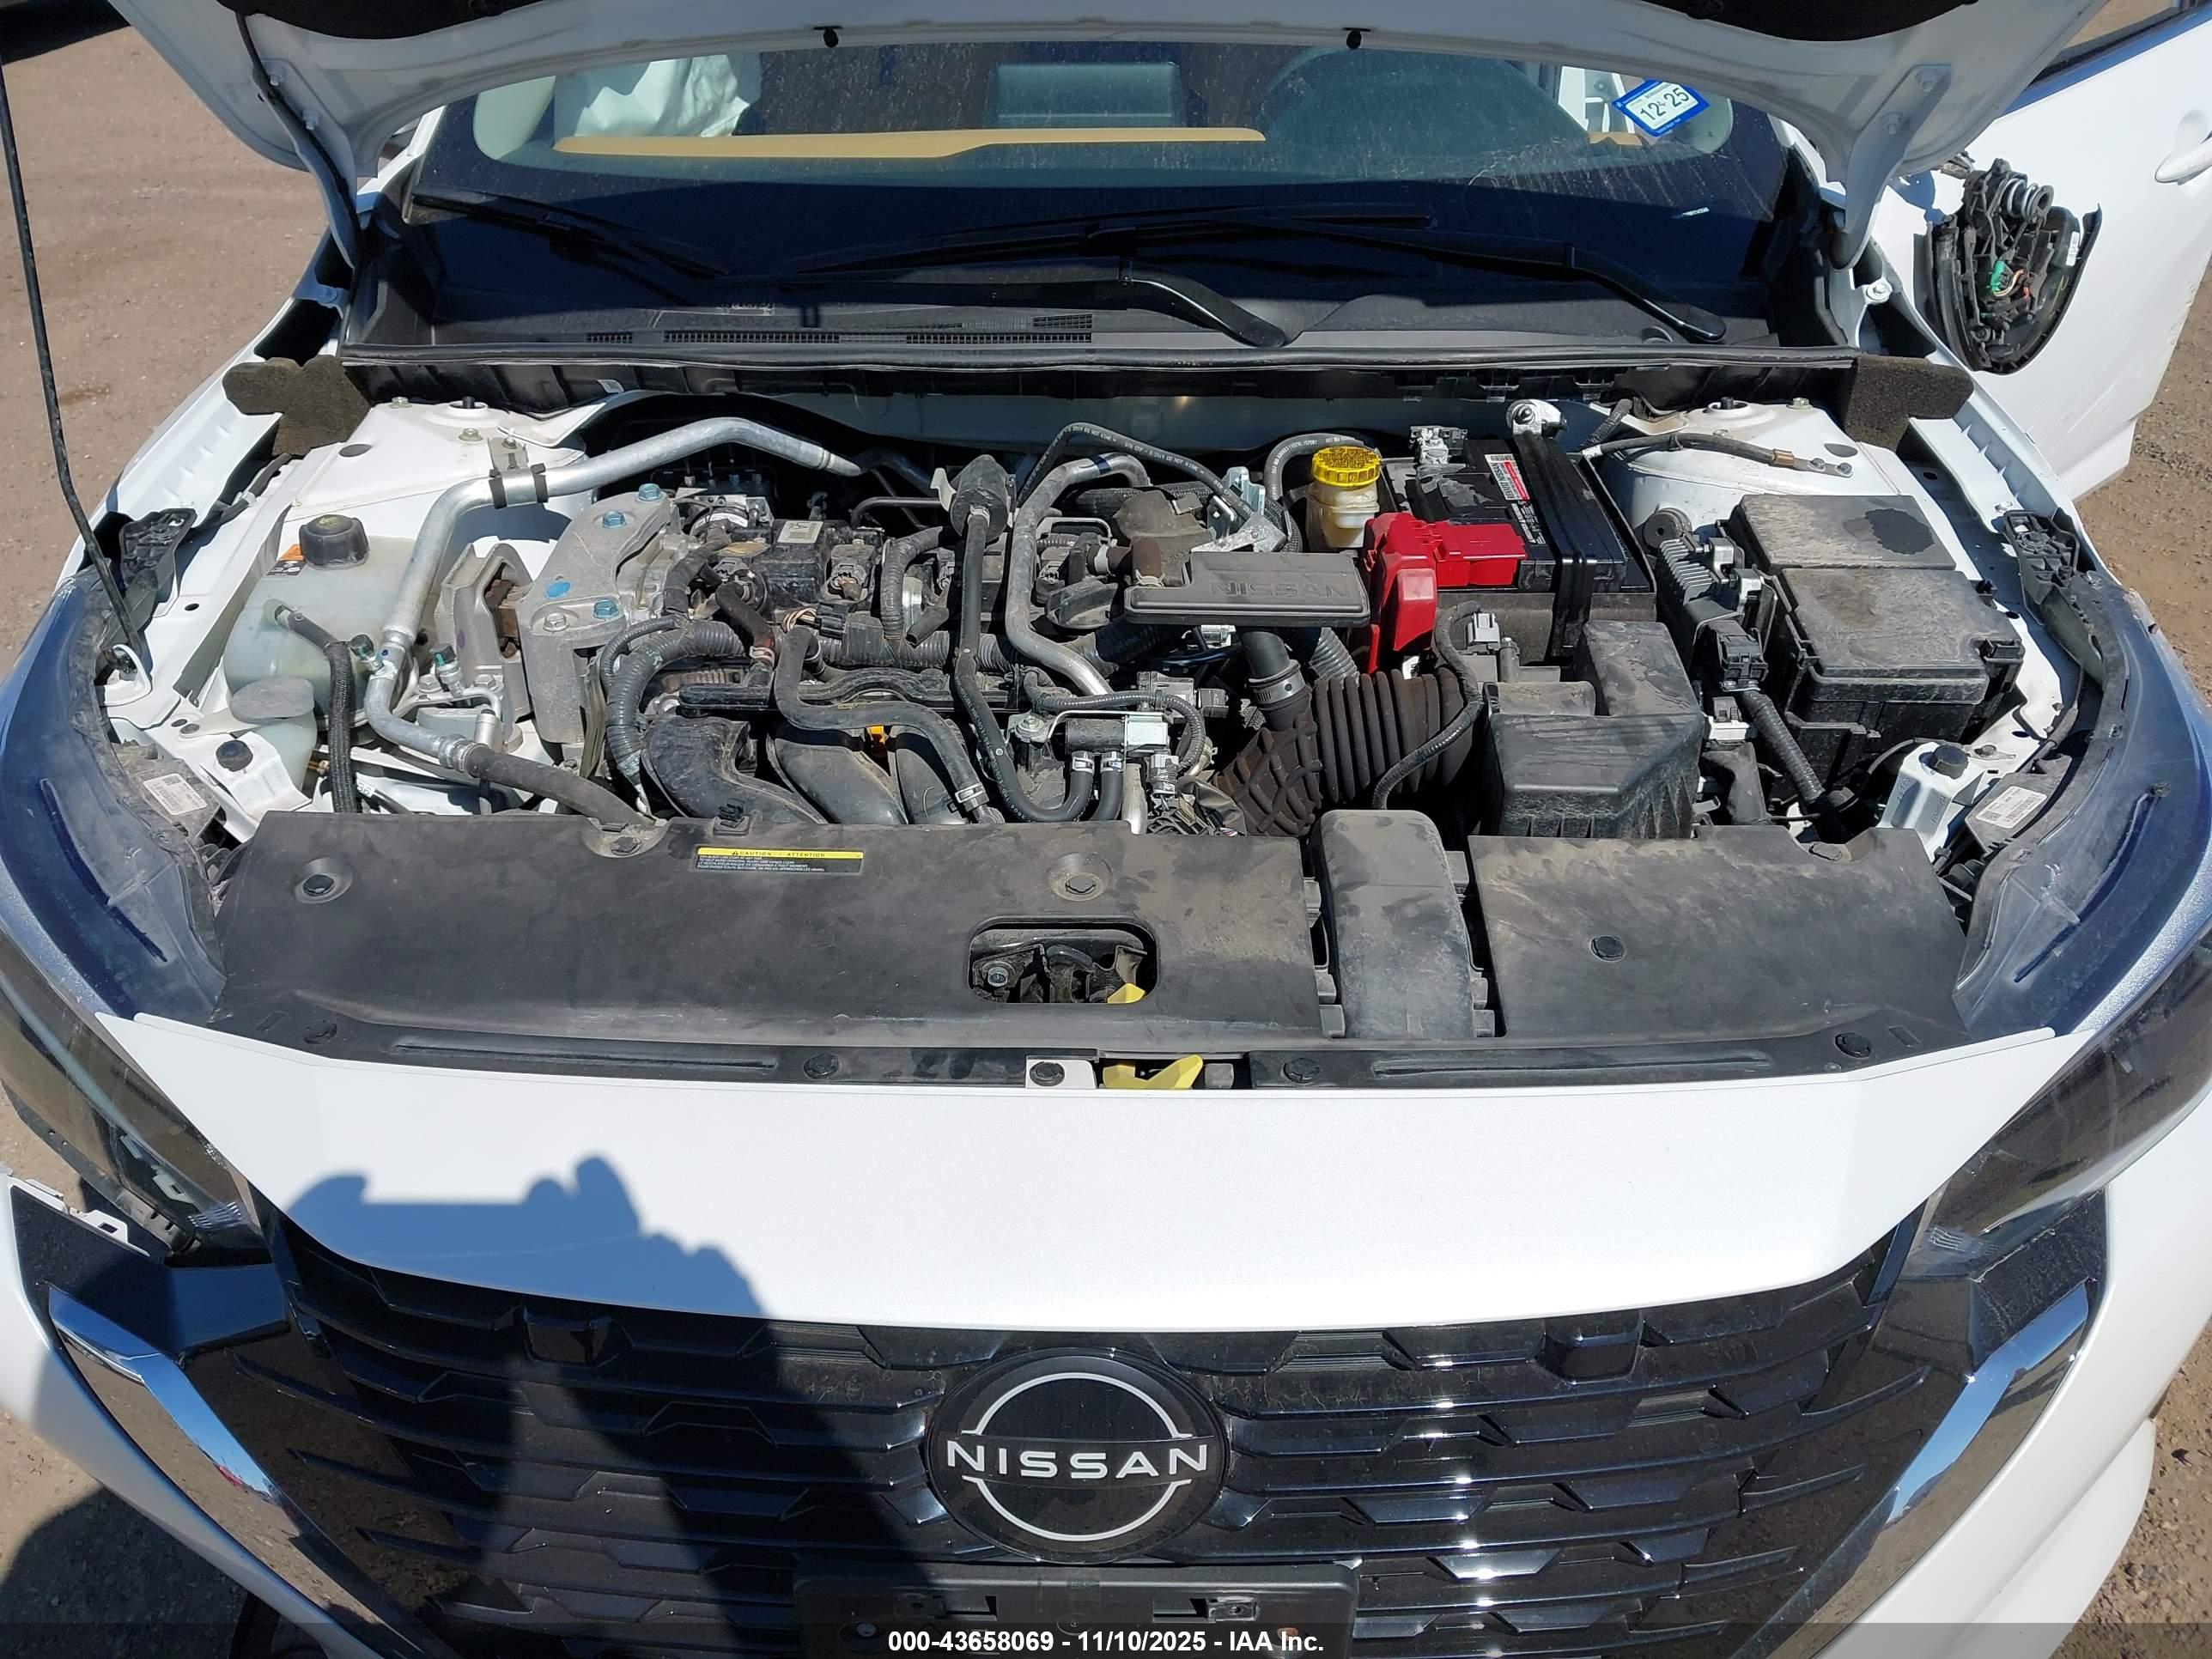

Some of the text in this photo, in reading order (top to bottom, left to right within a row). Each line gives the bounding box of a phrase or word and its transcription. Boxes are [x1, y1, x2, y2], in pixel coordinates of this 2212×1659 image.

[1640, 102, 1666, 120] 12
[1663, 88, 1689, 107] 25
[1211, 581, 1352, 598] NISSAN
[947, 1440, 1207, 1479] NISSAN
